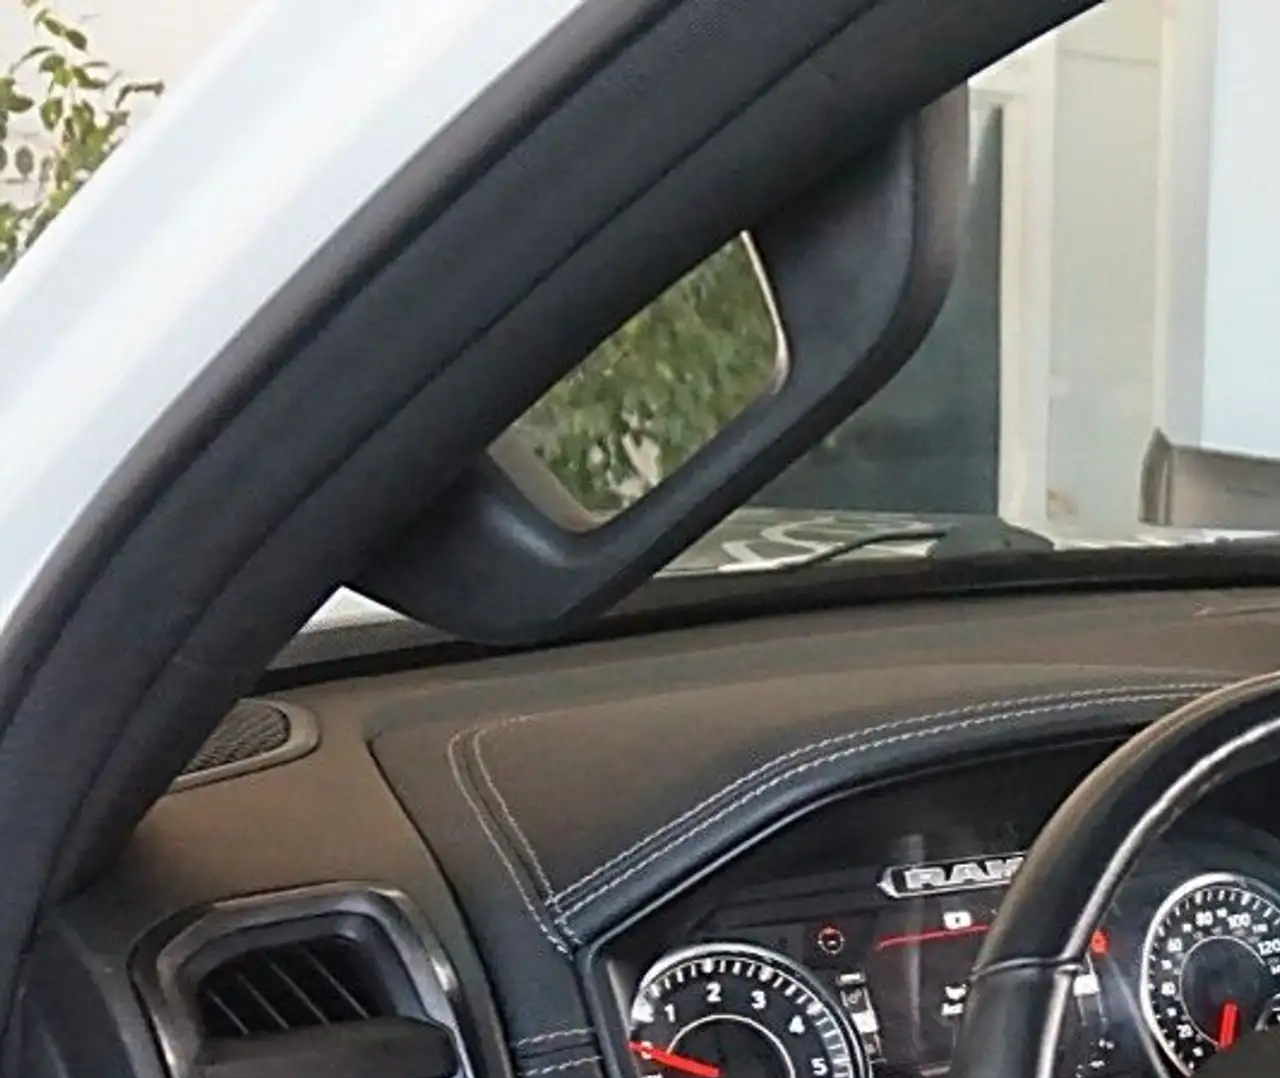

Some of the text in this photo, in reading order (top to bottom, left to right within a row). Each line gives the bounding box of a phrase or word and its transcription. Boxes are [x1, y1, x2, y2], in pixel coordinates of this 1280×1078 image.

[706, 982, 721, 1002] 2
[751, 990, 767, 1010] 3
[664, 1003, 676, 1023] 1
[789, 1015, 806, 1034] 4
[811, 1057, 828, 1077] 5
